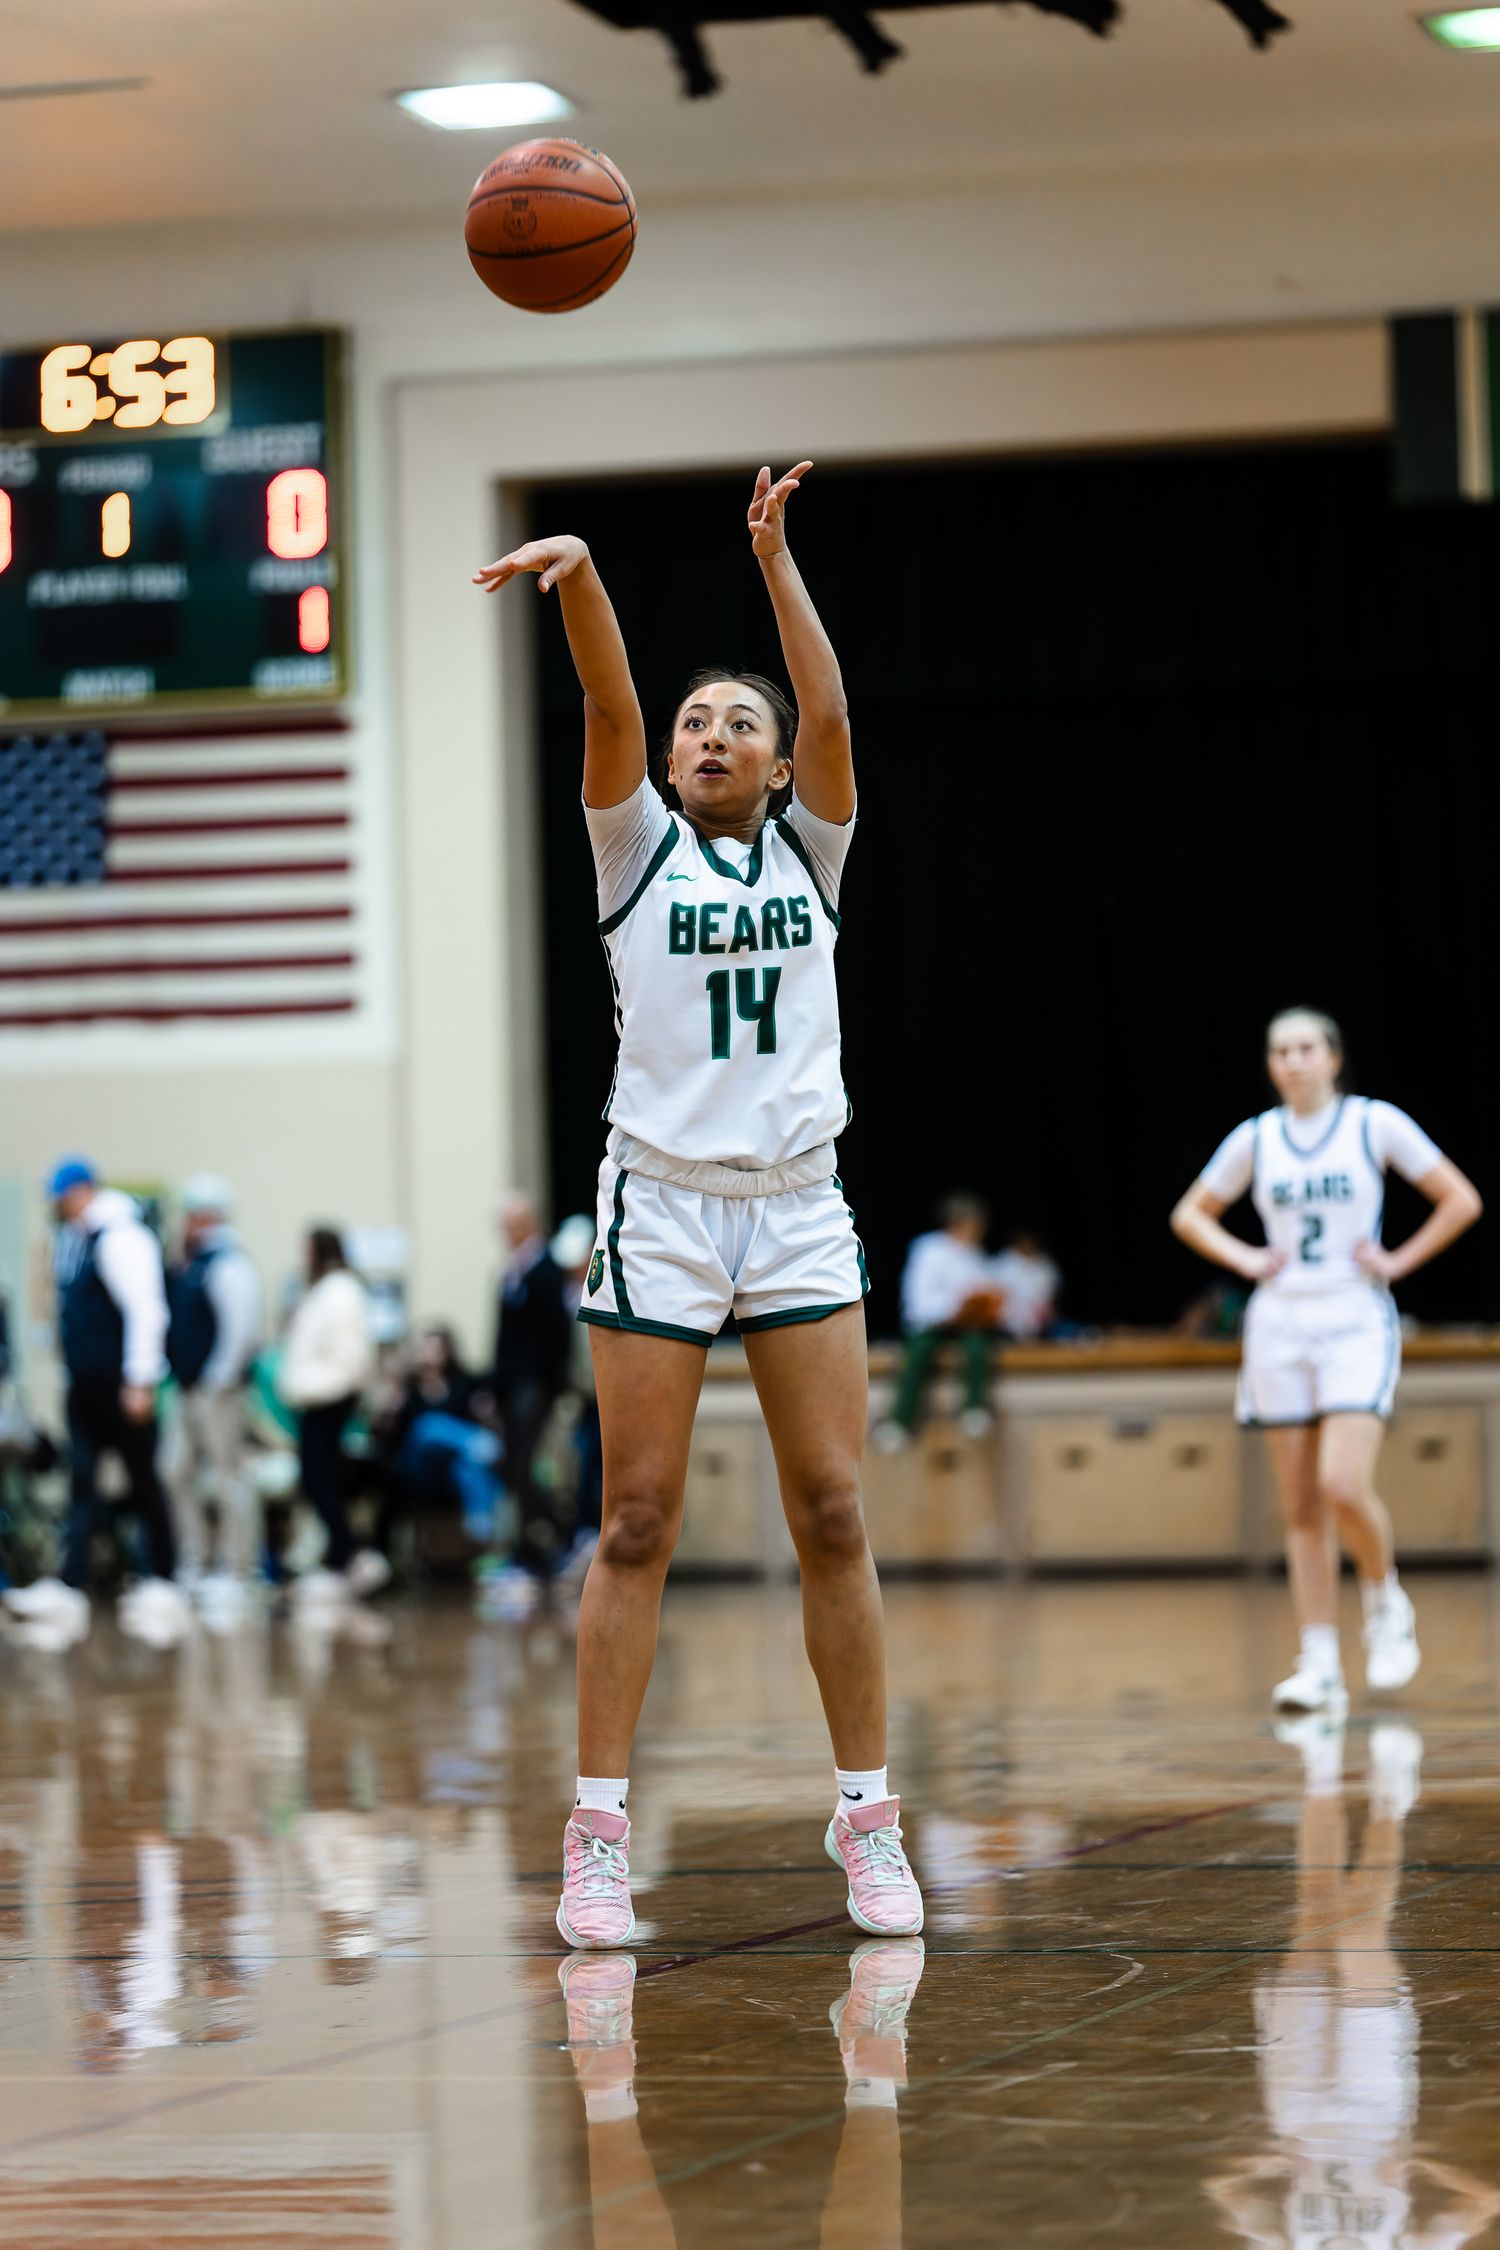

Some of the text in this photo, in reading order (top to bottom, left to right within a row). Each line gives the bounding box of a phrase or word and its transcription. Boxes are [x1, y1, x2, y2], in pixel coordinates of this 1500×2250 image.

[40, 336, 216, 433] 6:53
[102, 492, 131, 558] 1
[266, 468, 328, 559] 0
[299, 585, 330, 653] 1
[668, 894, 813, 955] BEARS
[705, 966, 782, 1060] 14
[1271, 1173, 1351, 1207] BEARS
[1299, 1214, 1325, 1263] 2
